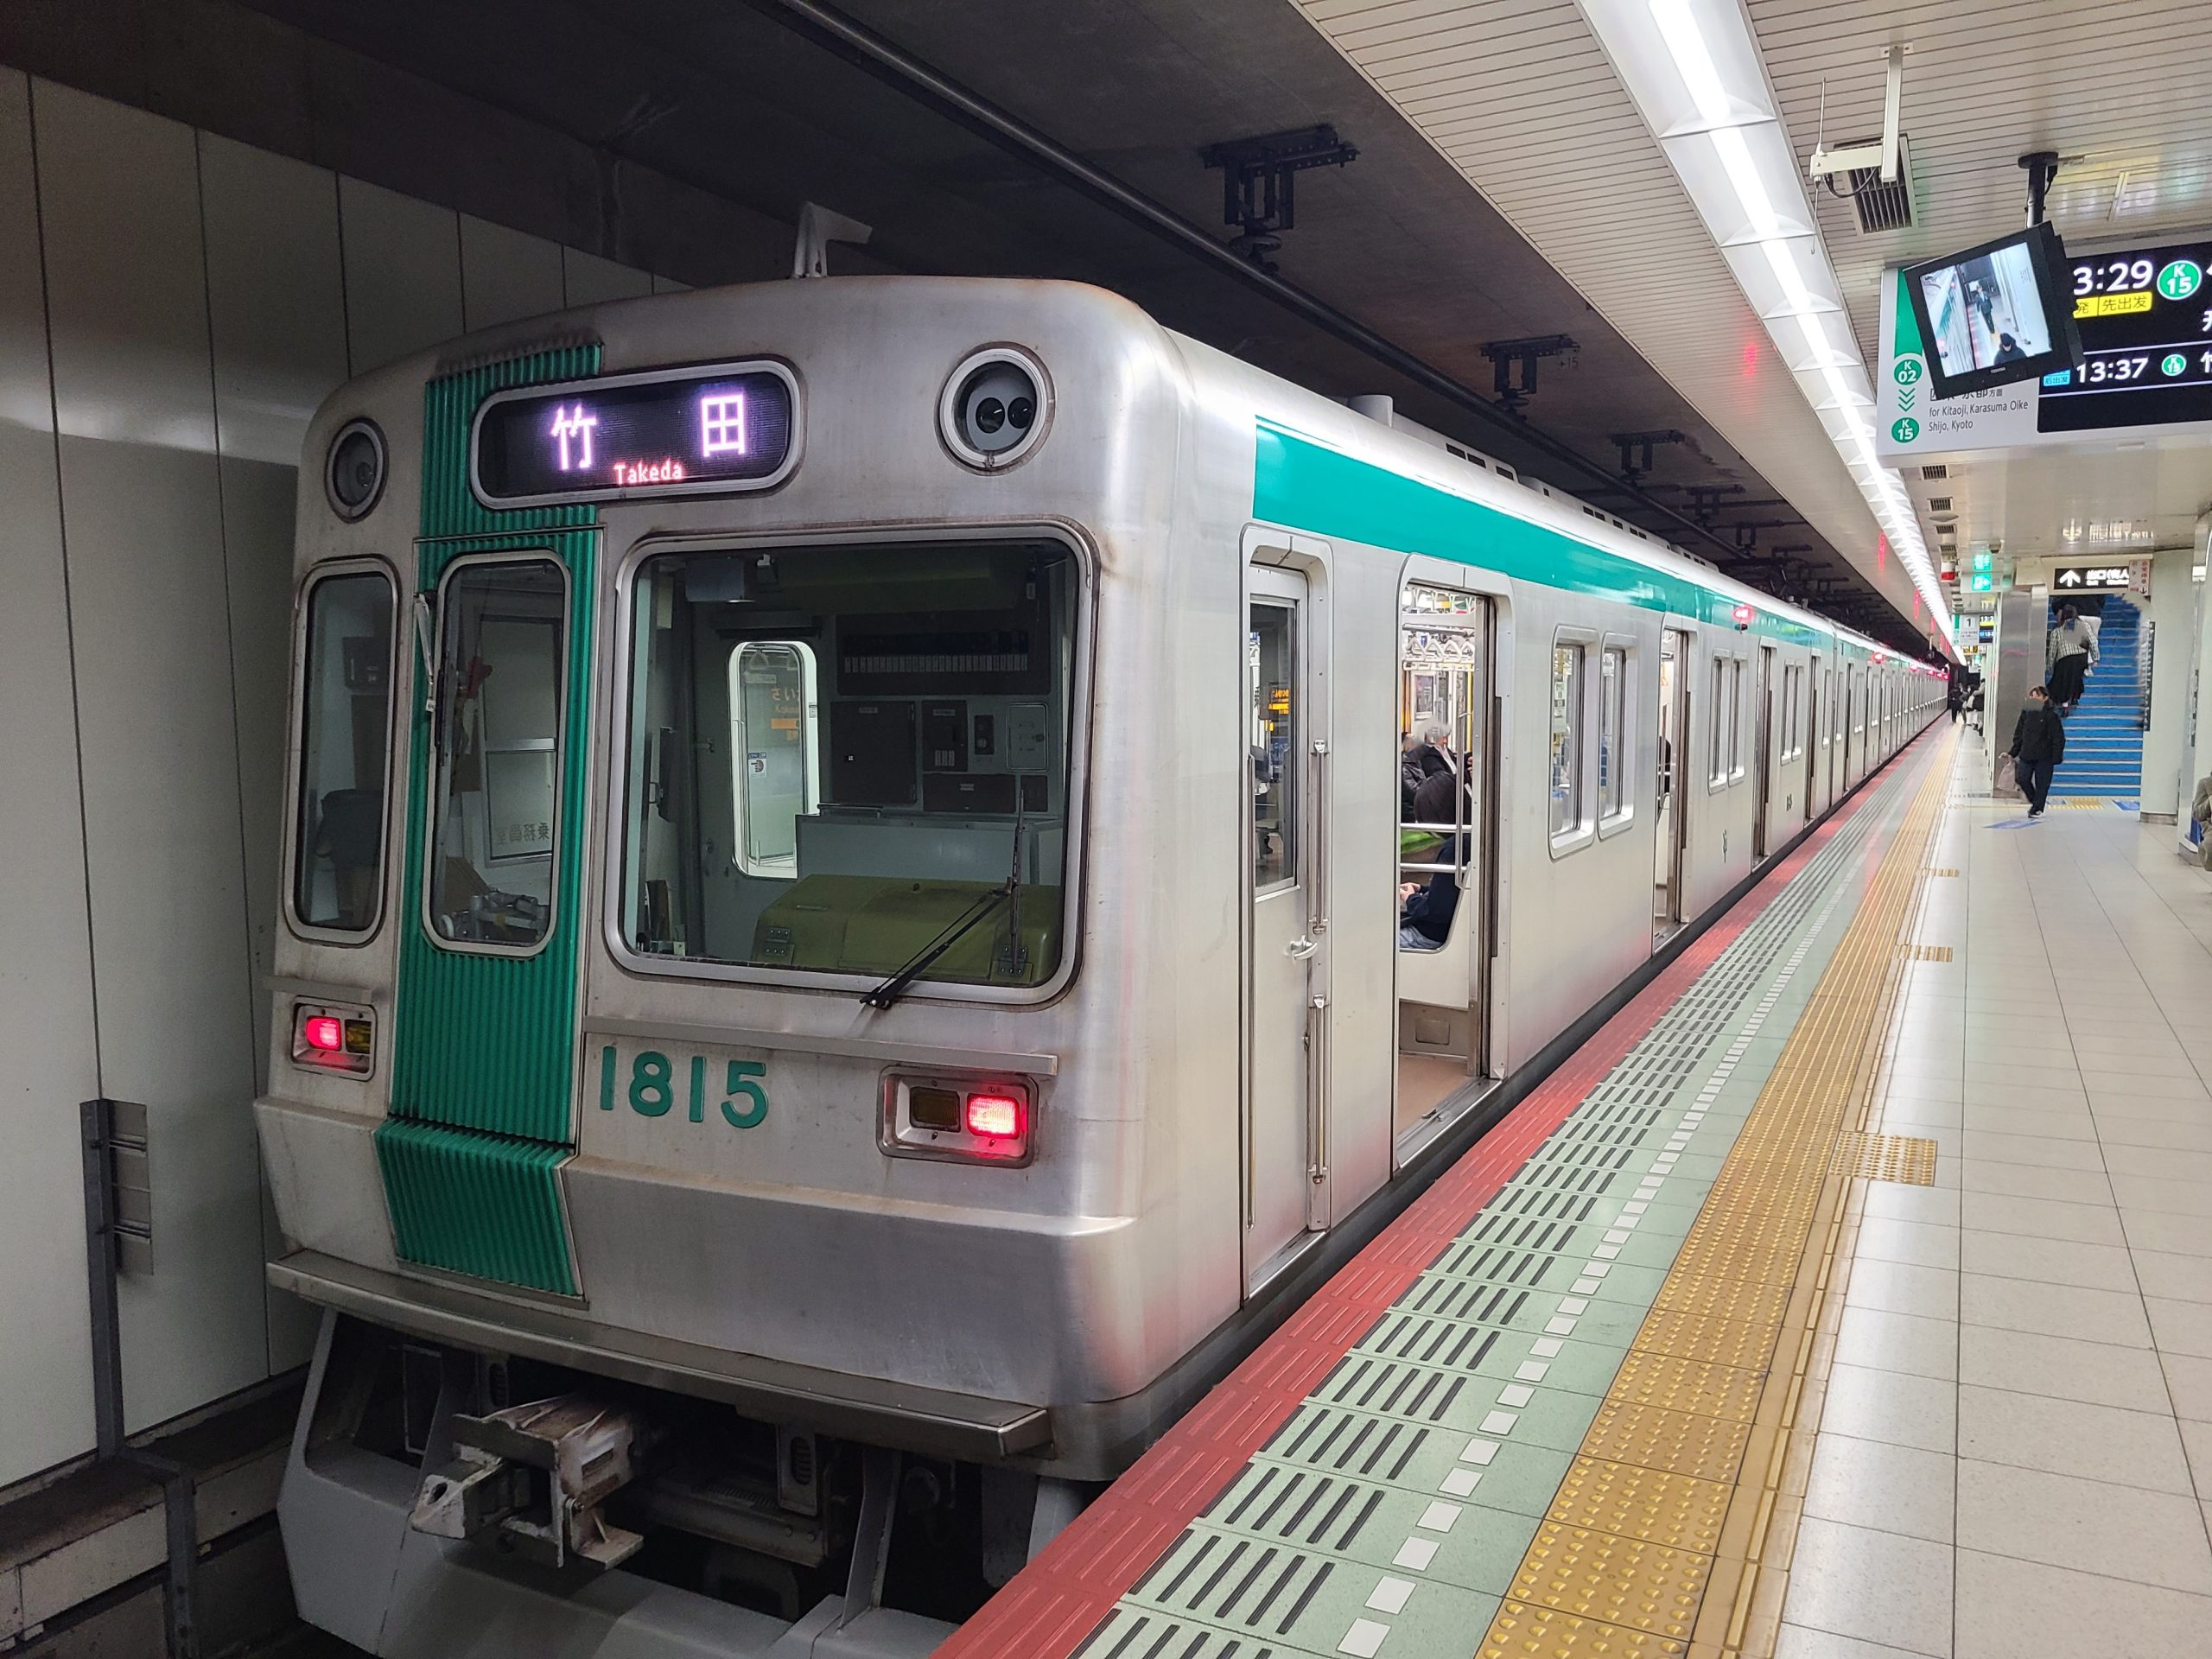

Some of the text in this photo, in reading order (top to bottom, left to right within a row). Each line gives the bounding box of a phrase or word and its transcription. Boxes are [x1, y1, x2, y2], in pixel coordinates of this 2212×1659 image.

[2173, 264, 2184, 277] K
[2073, 260, 2153, 296] 3:29
[2167, 276, 2192, 295] 15
[2076, 302, 2089, 315] 発
[1904, 360, 1912, 370] K
[2077, 357, 2149, 383] 13:37
[1898, 370, 1916, 383] 02
[1929, 399, 2029, 419] for Kitaoji, Karasuma Oike
[1901, 419, 1910, 429] K
[1951, 419, 1974, 431] Kyoto
[1897, 429, 1914, 441] 15
[613, 459, 683, 486] Takeda
[599, 1045, 769, 1129] 1815
